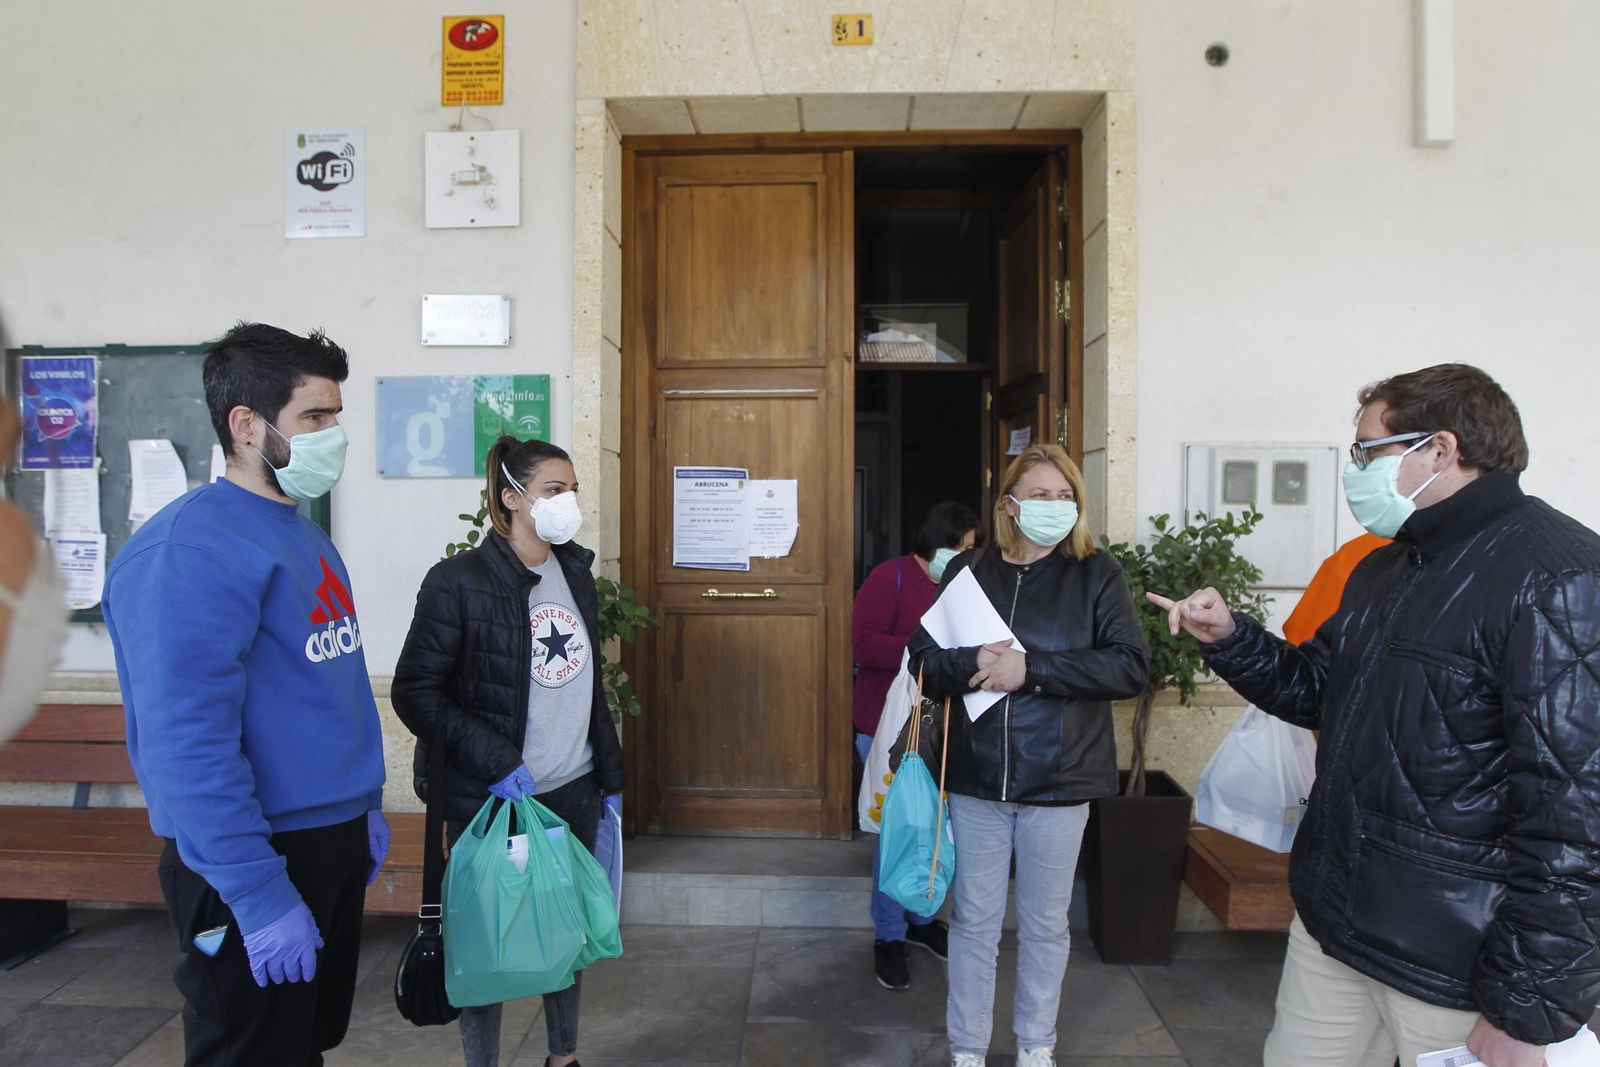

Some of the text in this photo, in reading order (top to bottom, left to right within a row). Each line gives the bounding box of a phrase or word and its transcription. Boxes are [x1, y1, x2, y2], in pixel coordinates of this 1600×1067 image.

[857, 20, 864, 37] 1
[468, 301, 498, 310] LOCAL
[453, 311, 495, 320] EMPLEO
[534, 657, 581, 681] ALL STAR
